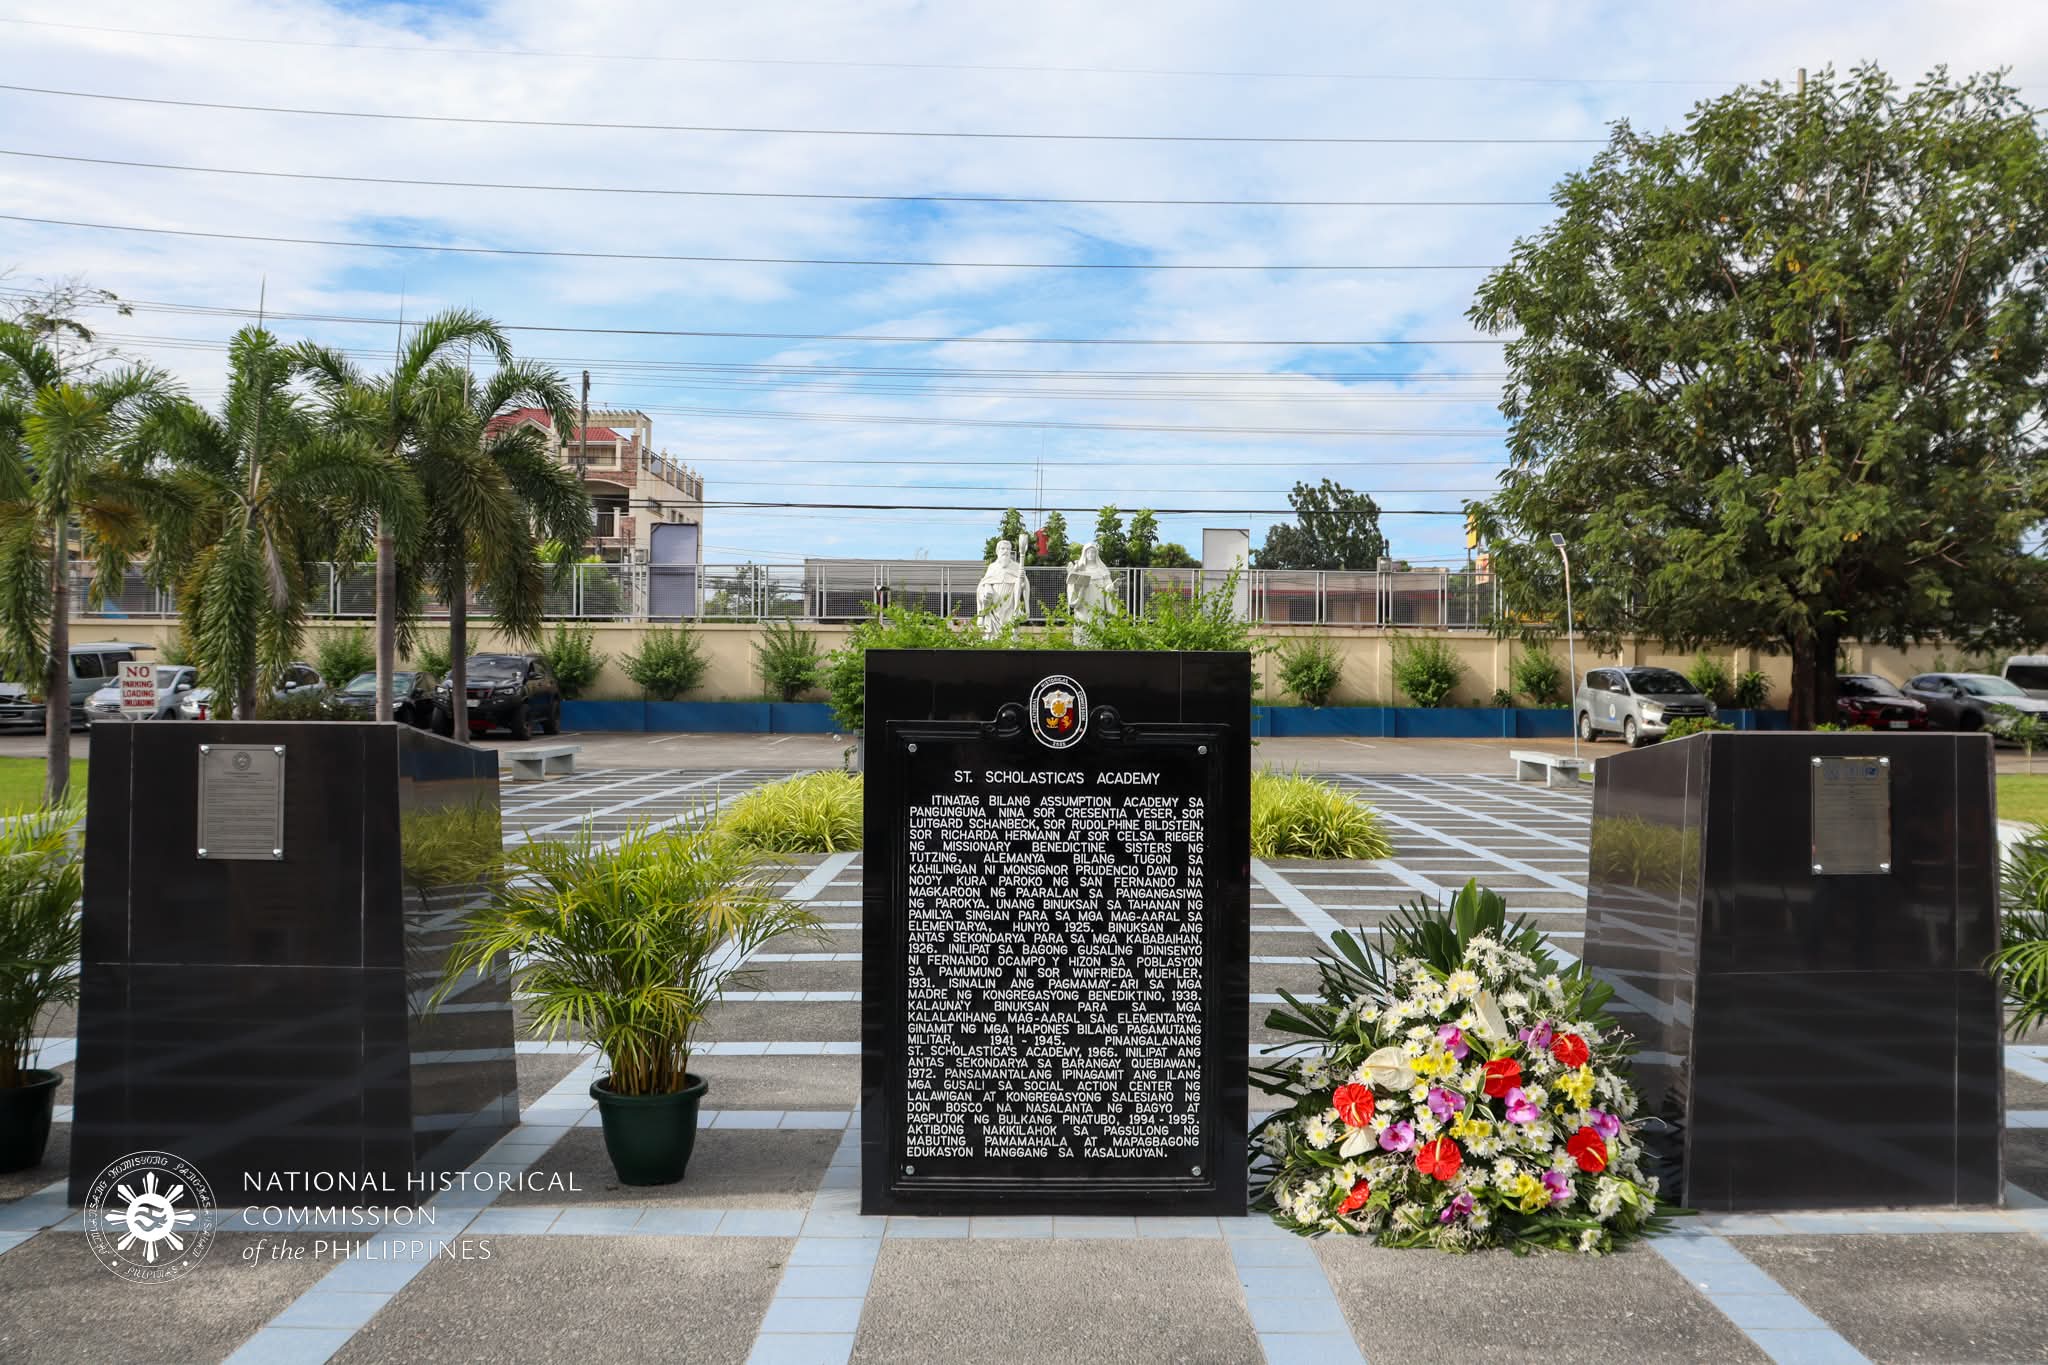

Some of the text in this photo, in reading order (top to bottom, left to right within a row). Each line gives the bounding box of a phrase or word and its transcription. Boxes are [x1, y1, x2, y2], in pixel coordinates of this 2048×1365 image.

[127, 666, 150, 678] NO
[122, 680, 153, 688] PARKING
[955, 770, 1160, 784] ST. SCHOLASTICA'S ACADEMY
[932, 795, 1204, 807] ITINATAG BILANG ASSUMPTION ACADEMY SA
[910, 807, 1204, 820] PANGUNGUNA NINA SOR CRESENTIA VESER, SOR
[910, 818, 1203, 831] LUITGARD SCHANBECK, SOR RUDOLPHINE BILDSTEIN,
[910, 829, 1203, 841] SOR RICHARDA HERMANN AT SOR CELSA RIEGER
[910, 841, 1203, 853] NG MISSIONARY BENEDICTINE SISTERS NG
[910, 852, 1203, 864] TUTZING, ALEMANYA BILANG TUGON SA
[909, 864, 1203, 876] KAHILINGAN NI MONSIGNOR PRUDENCIO DAVID NA
[909, 875, 1203, 887] NOO'Y KURA PAROKO NG SAN FERNANDO NA
[909, 887, 1203, 899] MAGKAROON NG PAARALAN SA PANGANGASIWA
[909, 909, 1202, 921] PAMILYA SINGIAN PARA SA MGA MAG-AARAL SA
[909, 921, 1202, 933] ELEMENTARYA, HUNYO 1925. BINUKSAN ANG
[909, 932, 1202, 946] ANTAS SEKONDARYA PARA SA MGA KABABAIHAN,
[909, 943, 1202, 955] 1926. INILIPAT SA BAGONG GUSALING IDINISENYO
[908, 966, 1202, 980] SA PAMUMUNO NI SOR WINFRIEDA MUEHLER,
[908, 989, 1201, 1003] MADRE NG KONGREGASYONG BENEDIKTINO, 1938.
[908, 1000, 1201, 1012] KALAUNA'Y BINUKSAN PARA SA MGA
[908, 1012, 1201, 1023] KALALAKIHANG MAG-AARAL SA ELEMENTARYA.
[908, 1046, 1201, 1058] ST. SCHOLASTICA'S ACADEMY, 1966. INILIPAT ANG
[908, 1057, 1201, 1070] ANTAS SEKONDARYA SA BARANGAY QUEBIAWAN,
[908, 1068, 1200, 1080] 1972. PANSAMANTALANG IPINAGAMIT ANG ILANG
[908, 1091, 1200, 1102] LALAWIGAN AT KONGREGASYONG SALESIANO NG
[908, 1124, 1199, 1136] AKTIBONG NAKIKILAHOK SA PAGSULONG NG
[907, 1136, 1199, 1146] MABUTING PAMAMAHALA AT MAPAGBAGONG
[907, 1147, 1167, 1157] EDUKASYON HANGGANG SA KASALUKUYAN.
